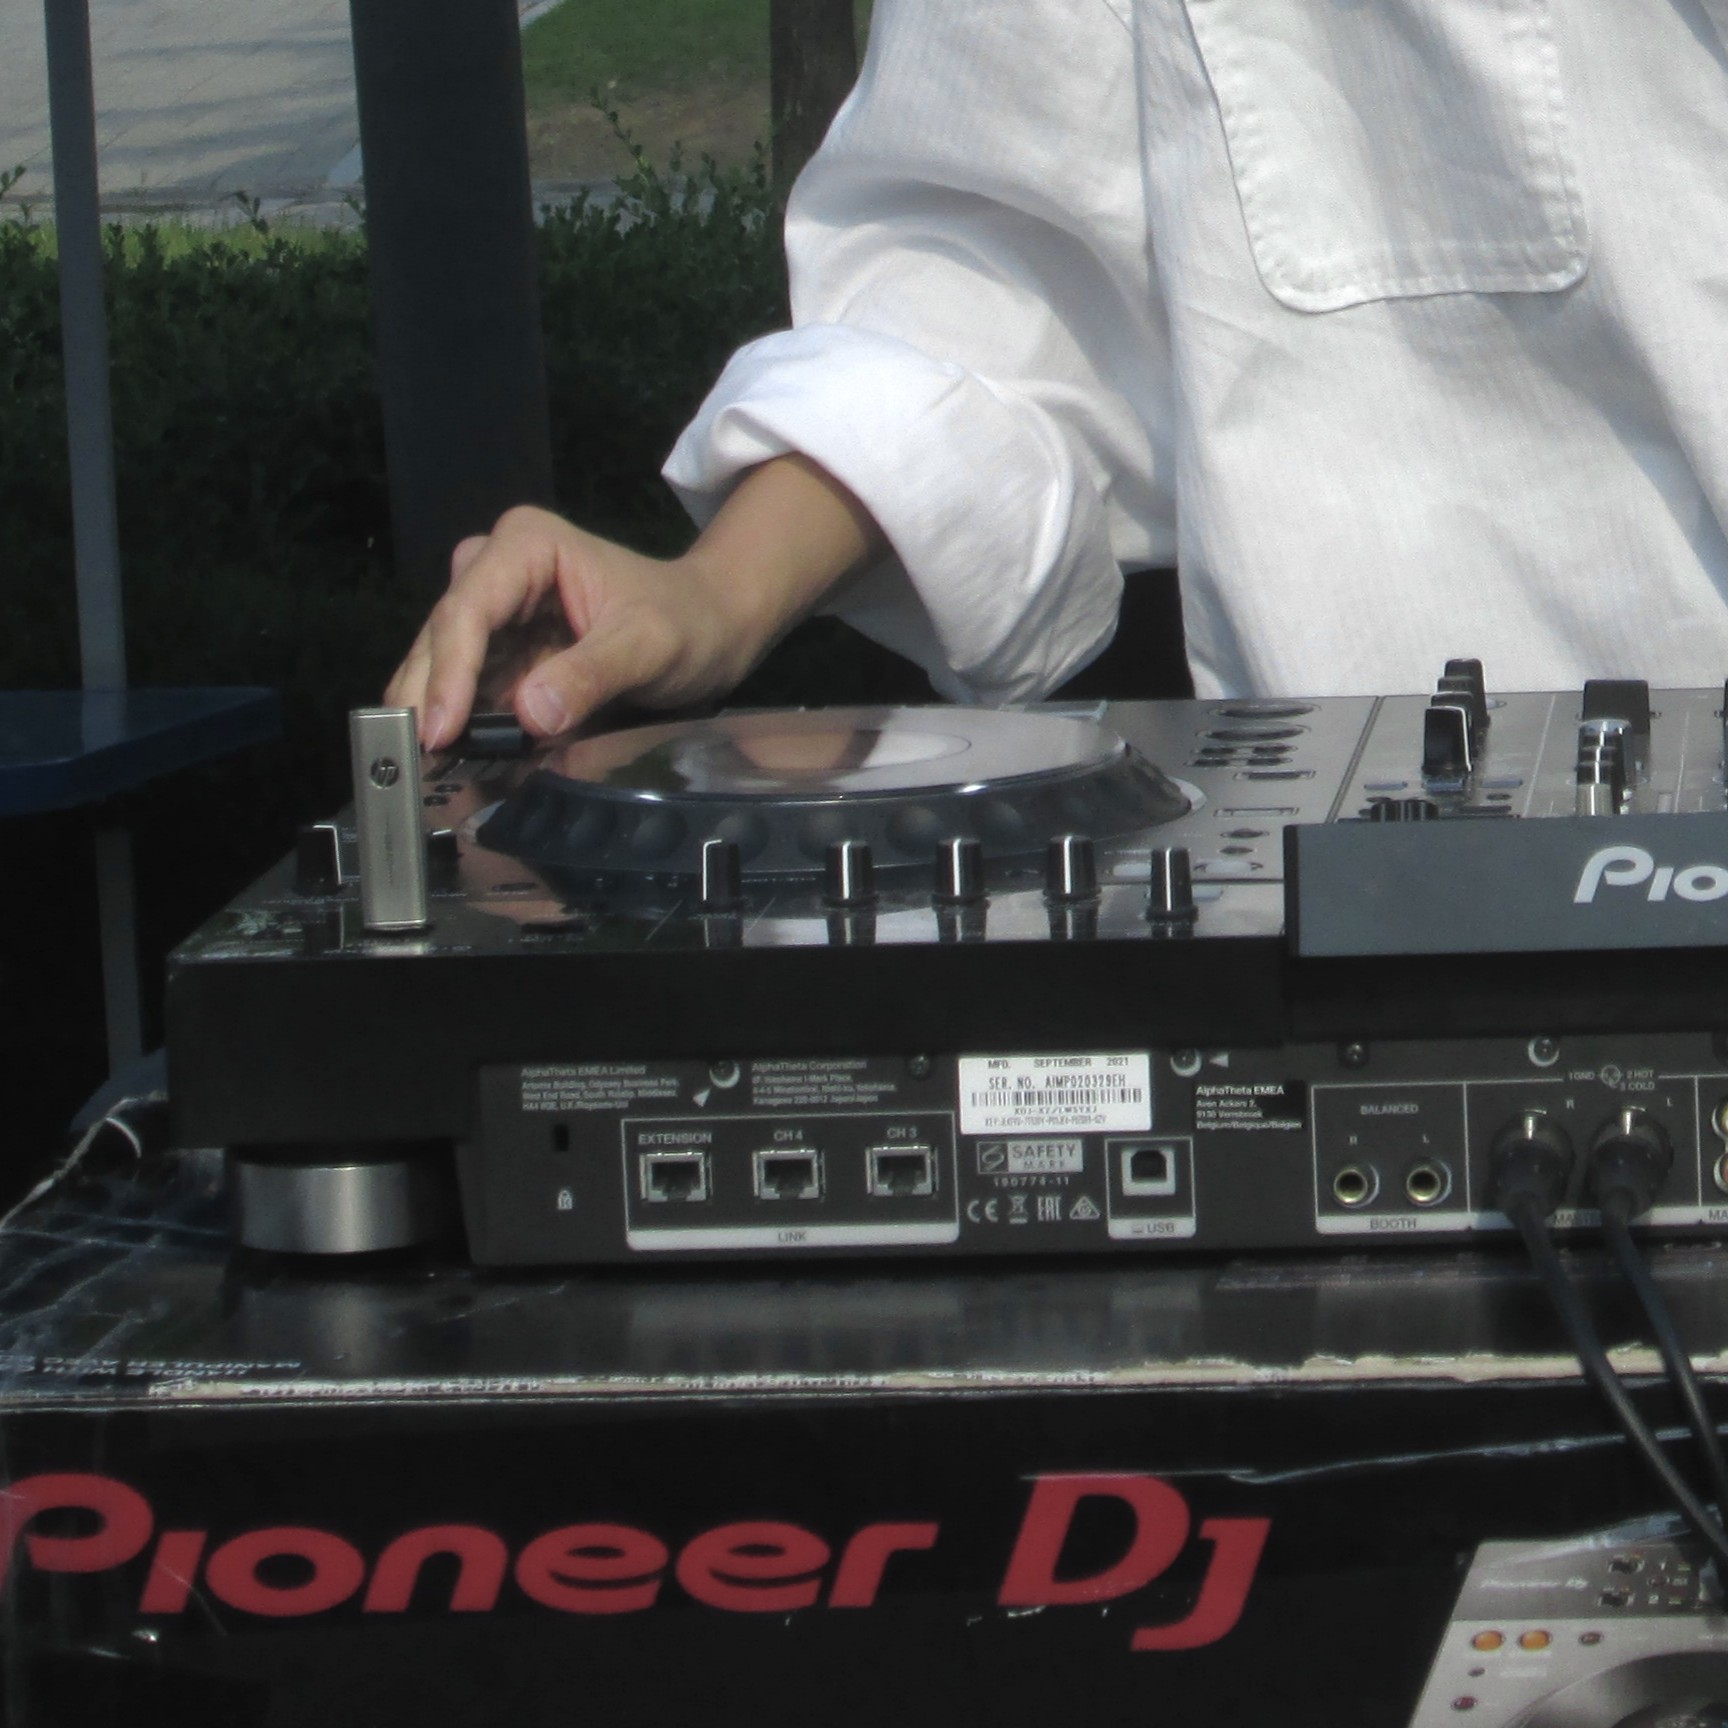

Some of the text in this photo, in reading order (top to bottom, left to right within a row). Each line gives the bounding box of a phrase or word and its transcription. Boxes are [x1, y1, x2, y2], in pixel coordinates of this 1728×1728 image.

[1033, 1057, 1092, 1069] SEPTEMBER
[988, 1076, 1011, 1090] SER.
[1017, 1075, 1036, 1090] NO.
[1253, 1085, 1285, 1095] EMEA
[1360, 1104, 1418, 1115] BALANCED
[638, 1132, 712, 1145] EXTENSION
[774, 1129, 803, 1142] CH 4
[887, 1127, 917, 1139] CH 3
[1013, 1144, 1076, 1159] SAFETY
[1147, 1221, 1175, 1235] USB
[1370, 1217, 1418, 1230] BOOTH
[777, 1231, 807, 1243] LINK
[0, 1473, 938, 1614] Pioneer
